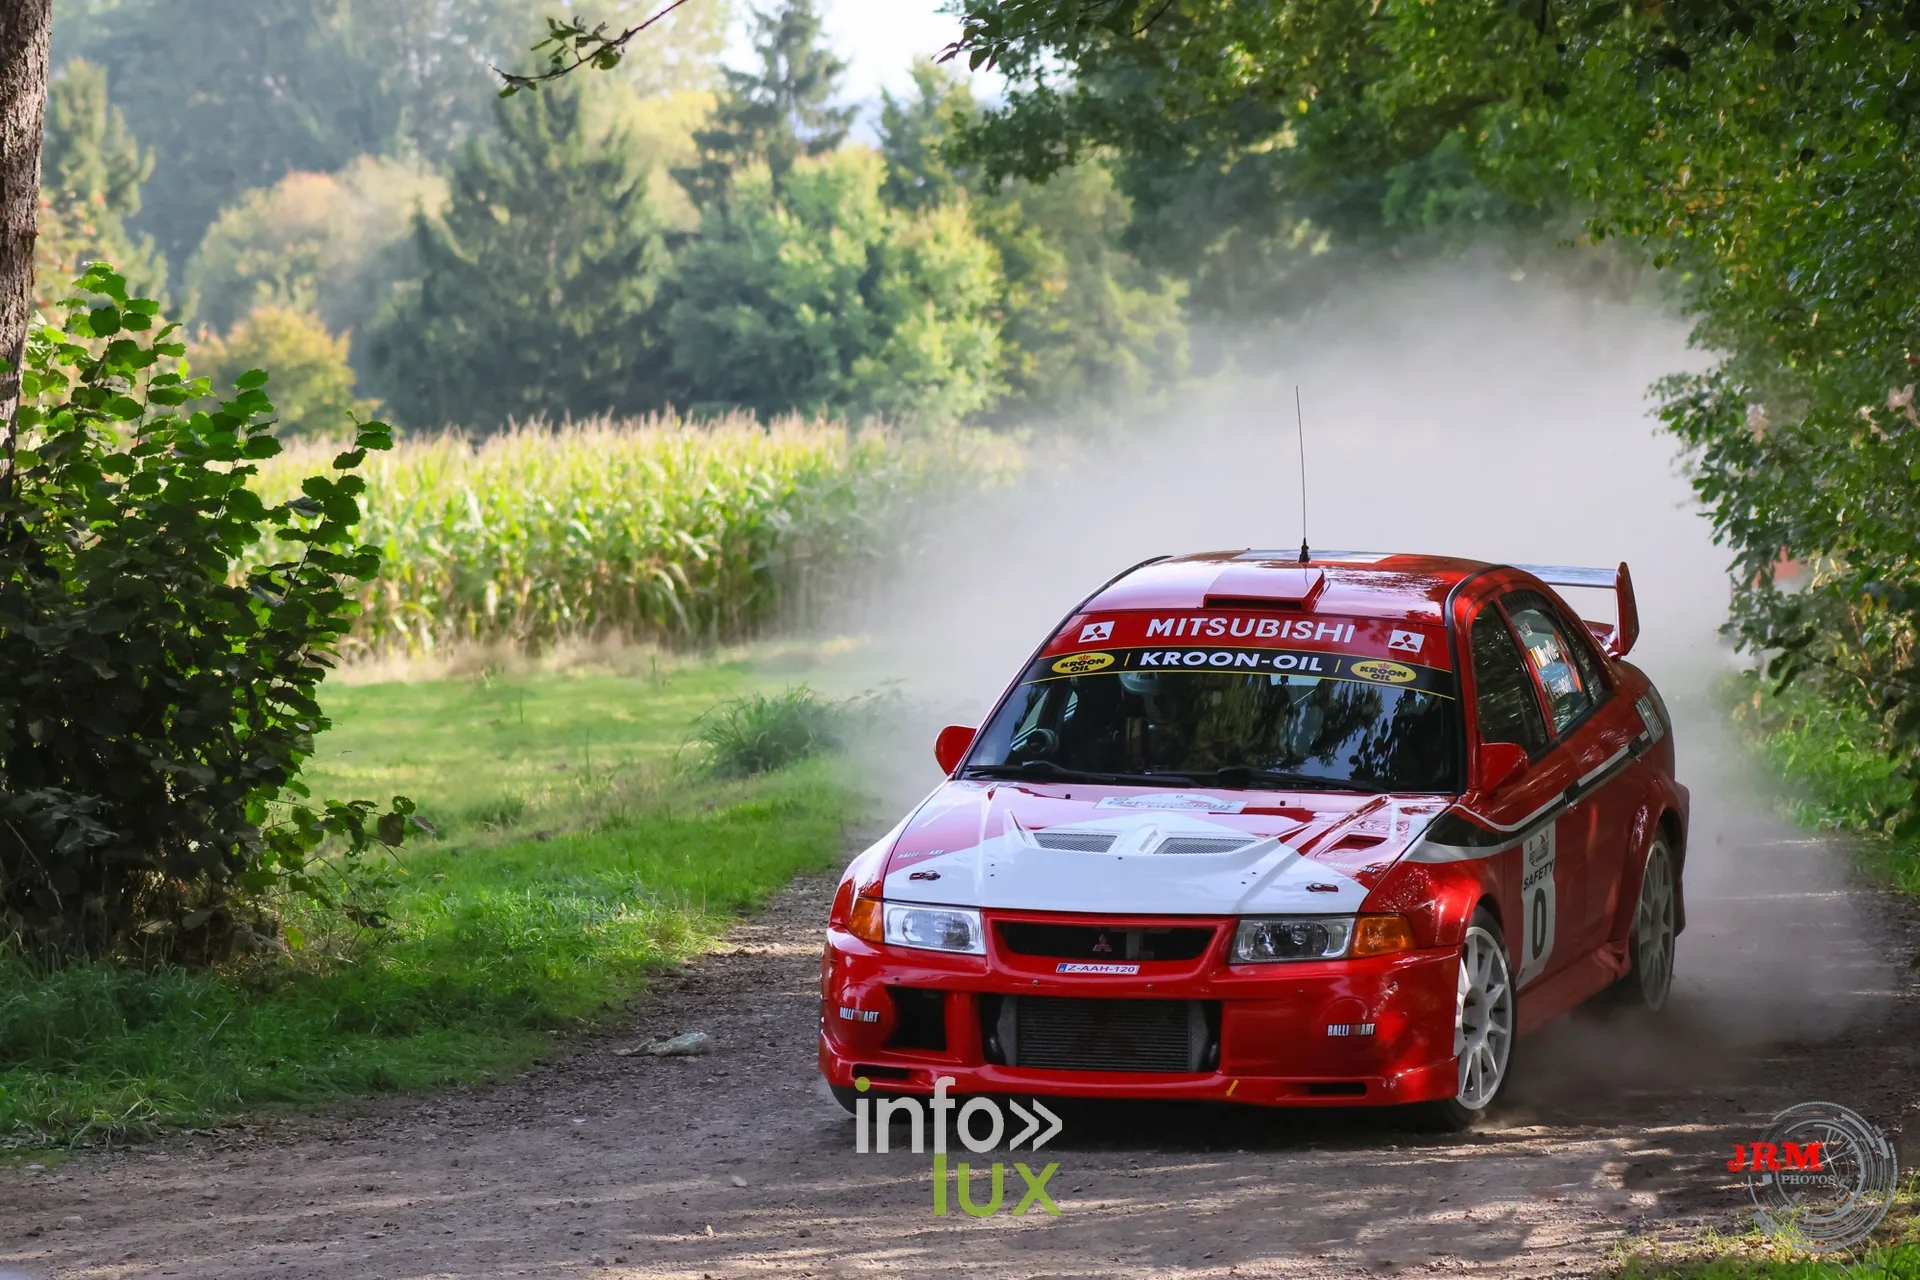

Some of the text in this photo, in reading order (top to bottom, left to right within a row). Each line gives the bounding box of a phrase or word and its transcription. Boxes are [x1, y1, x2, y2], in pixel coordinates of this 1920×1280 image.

[1145, 617, 1356, 643] MITSUBISHI
[1060, 658, 1106, 669] KROON
[1139, 651, 1323, 672] KROON-OIL
[1360, 666, 1407, 677] KROON
[1371, 673, 1391, 681] OIL
[1523, 858, 1555, 892] SAFETY
[1531, 887, 1547, 961] 0
[1068, 964, 1136, 973] Z-AAH-120
